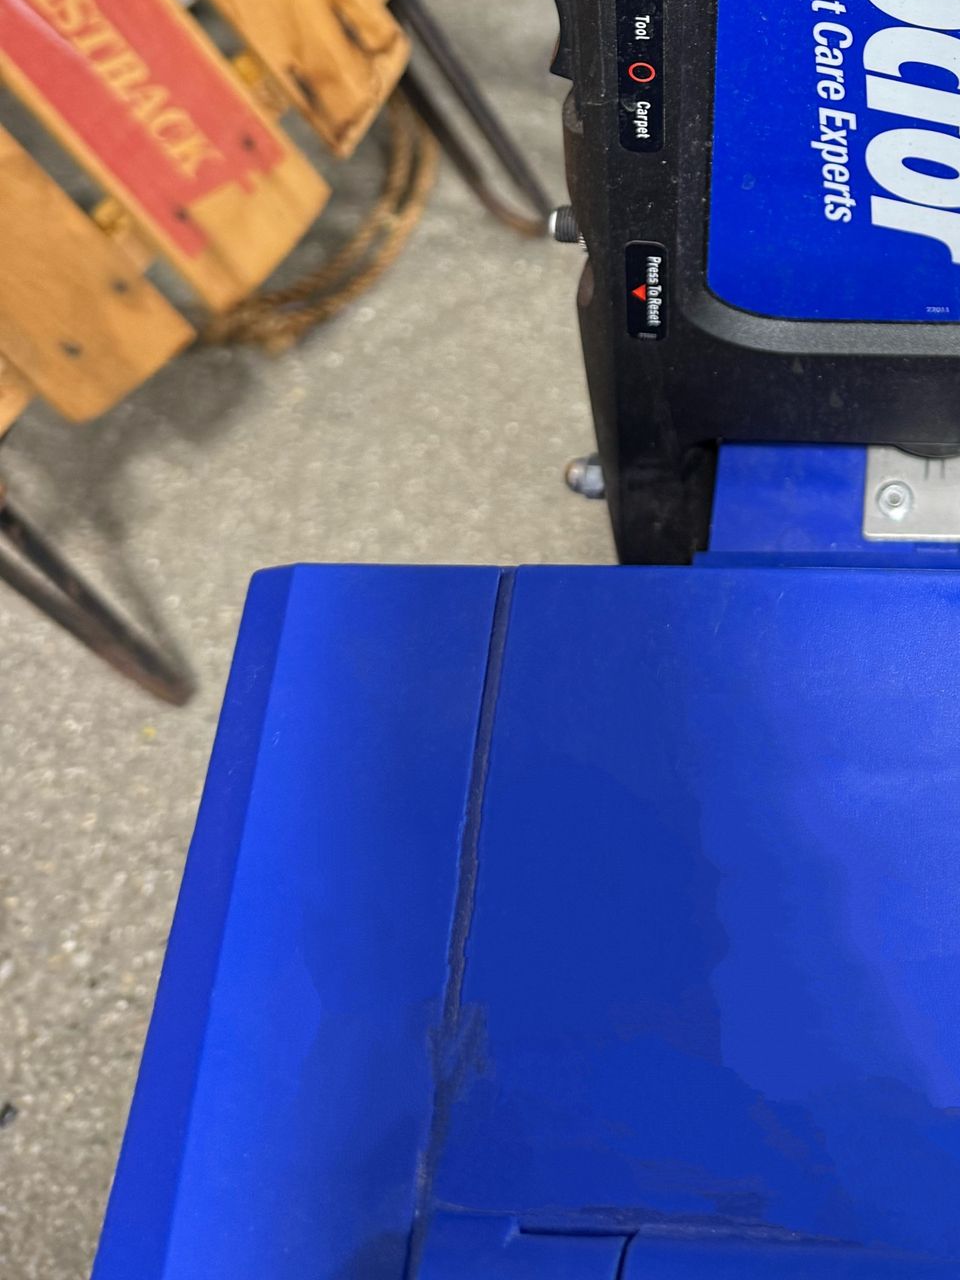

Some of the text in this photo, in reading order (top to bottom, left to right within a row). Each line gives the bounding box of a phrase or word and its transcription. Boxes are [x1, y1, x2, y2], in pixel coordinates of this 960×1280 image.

[634, 14, 651, 41] Tool
[812, 21, 853, 101] Care
[633, 100, 652, 139] Carpet
[810, 107, 857, 223] Experts
[646, 255, 662, 285] Press
[647, 284, 662, 298] To
[646, 297, 662, 327] Reset
